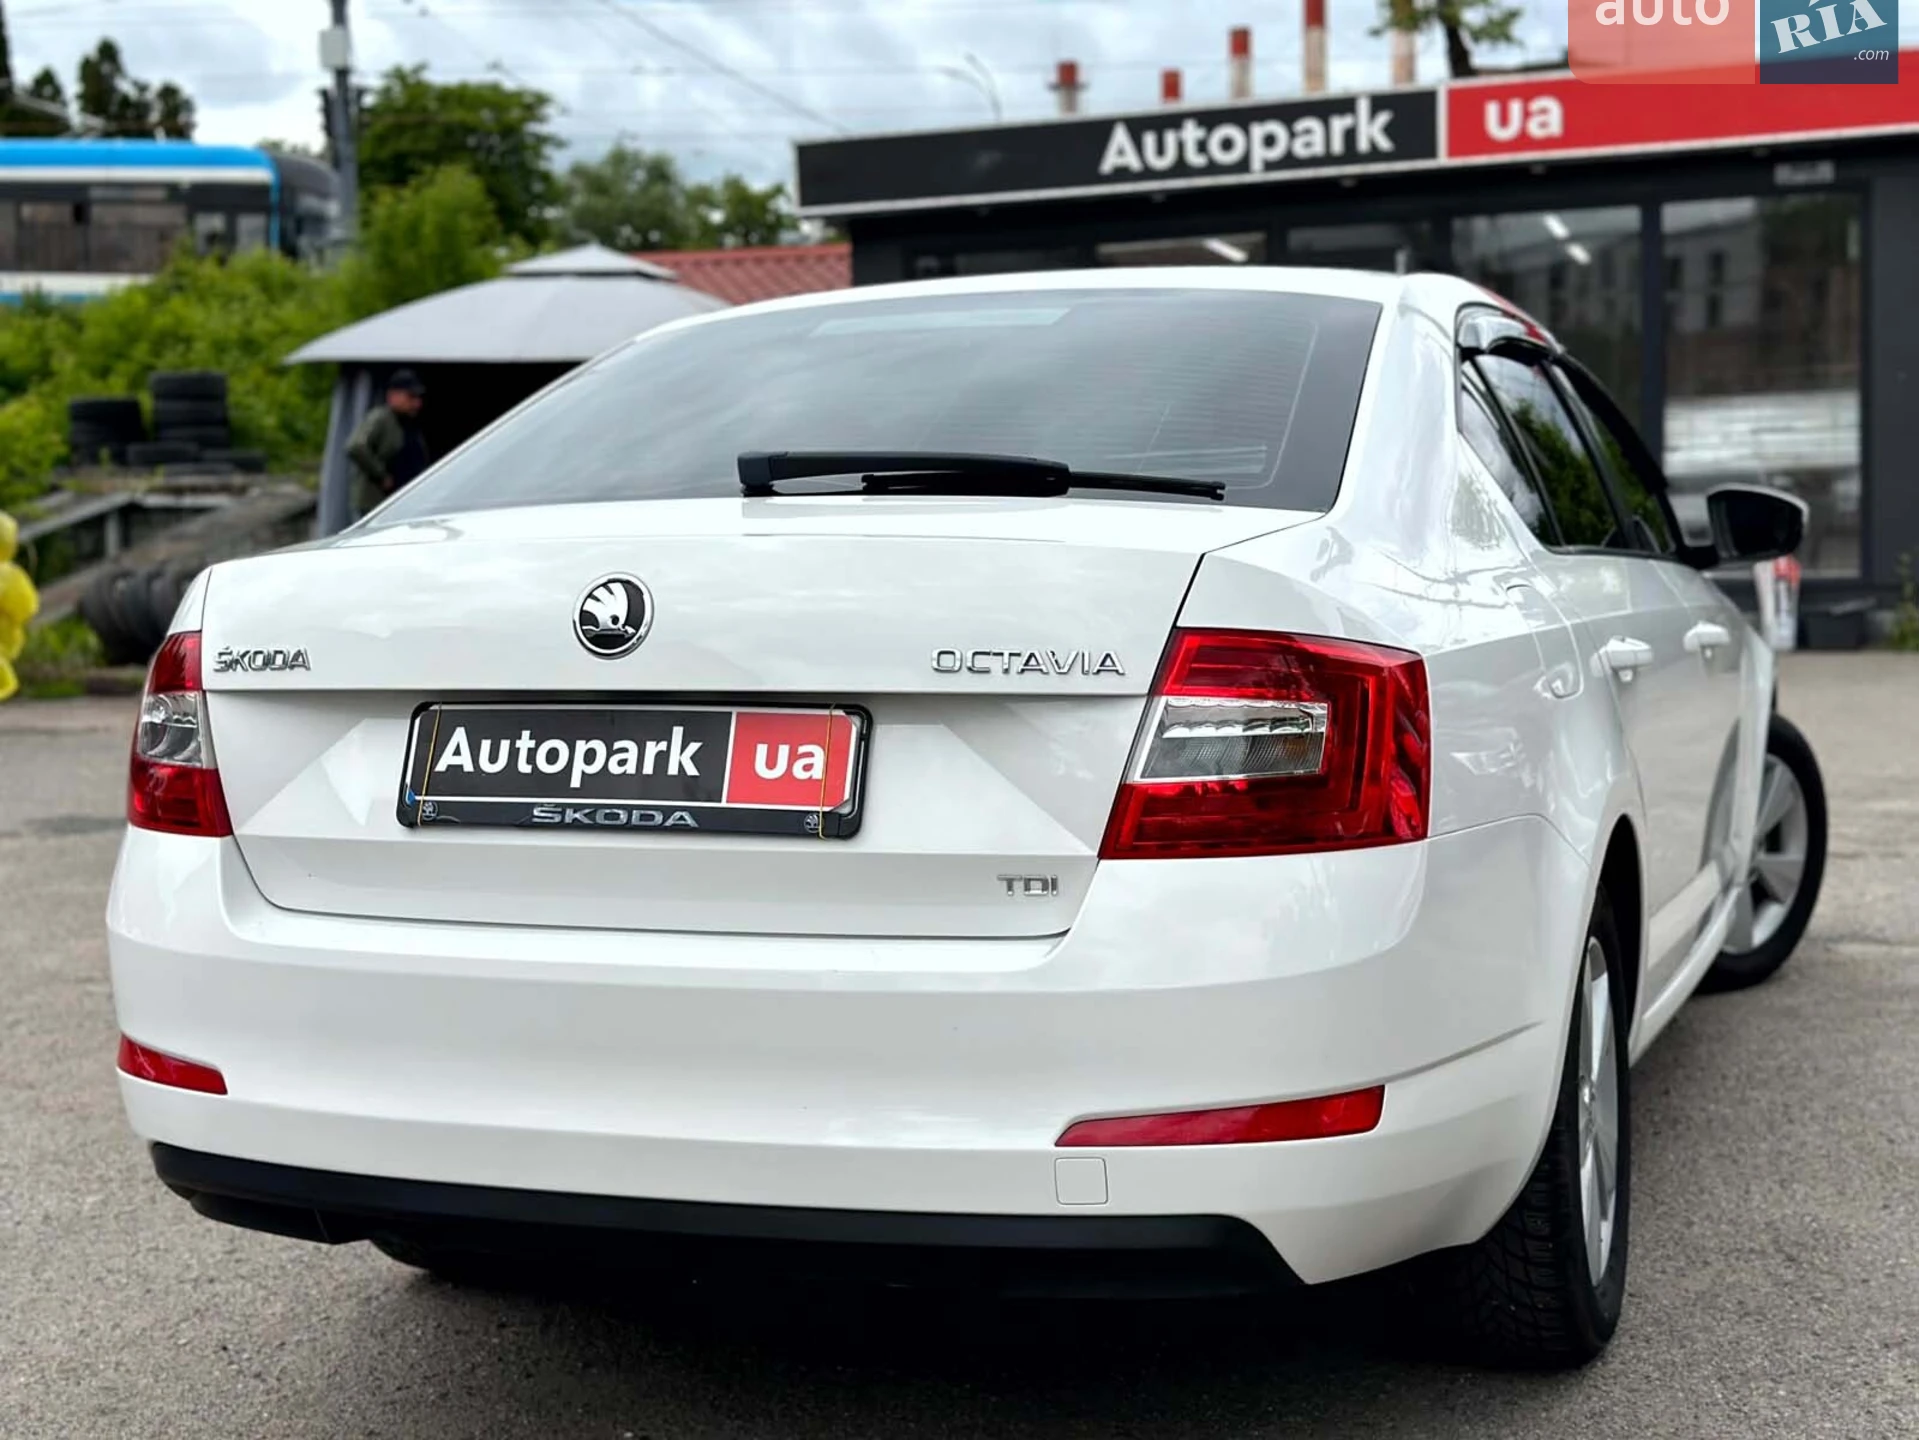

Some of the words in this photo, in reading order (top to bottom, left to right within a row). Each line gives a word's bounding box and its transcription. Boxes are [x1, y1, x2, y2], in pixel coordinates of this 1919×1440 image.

[1099, 94, 1395, 174] Autopark
[1484, 95, 1564, 142] ua
[931, 648, 1126, 676] OCTAVIA
[434, 726, 703, 788] Autopark
[754, 741, 826, 781] ua
[997, 873, 1058, 897] TDI
